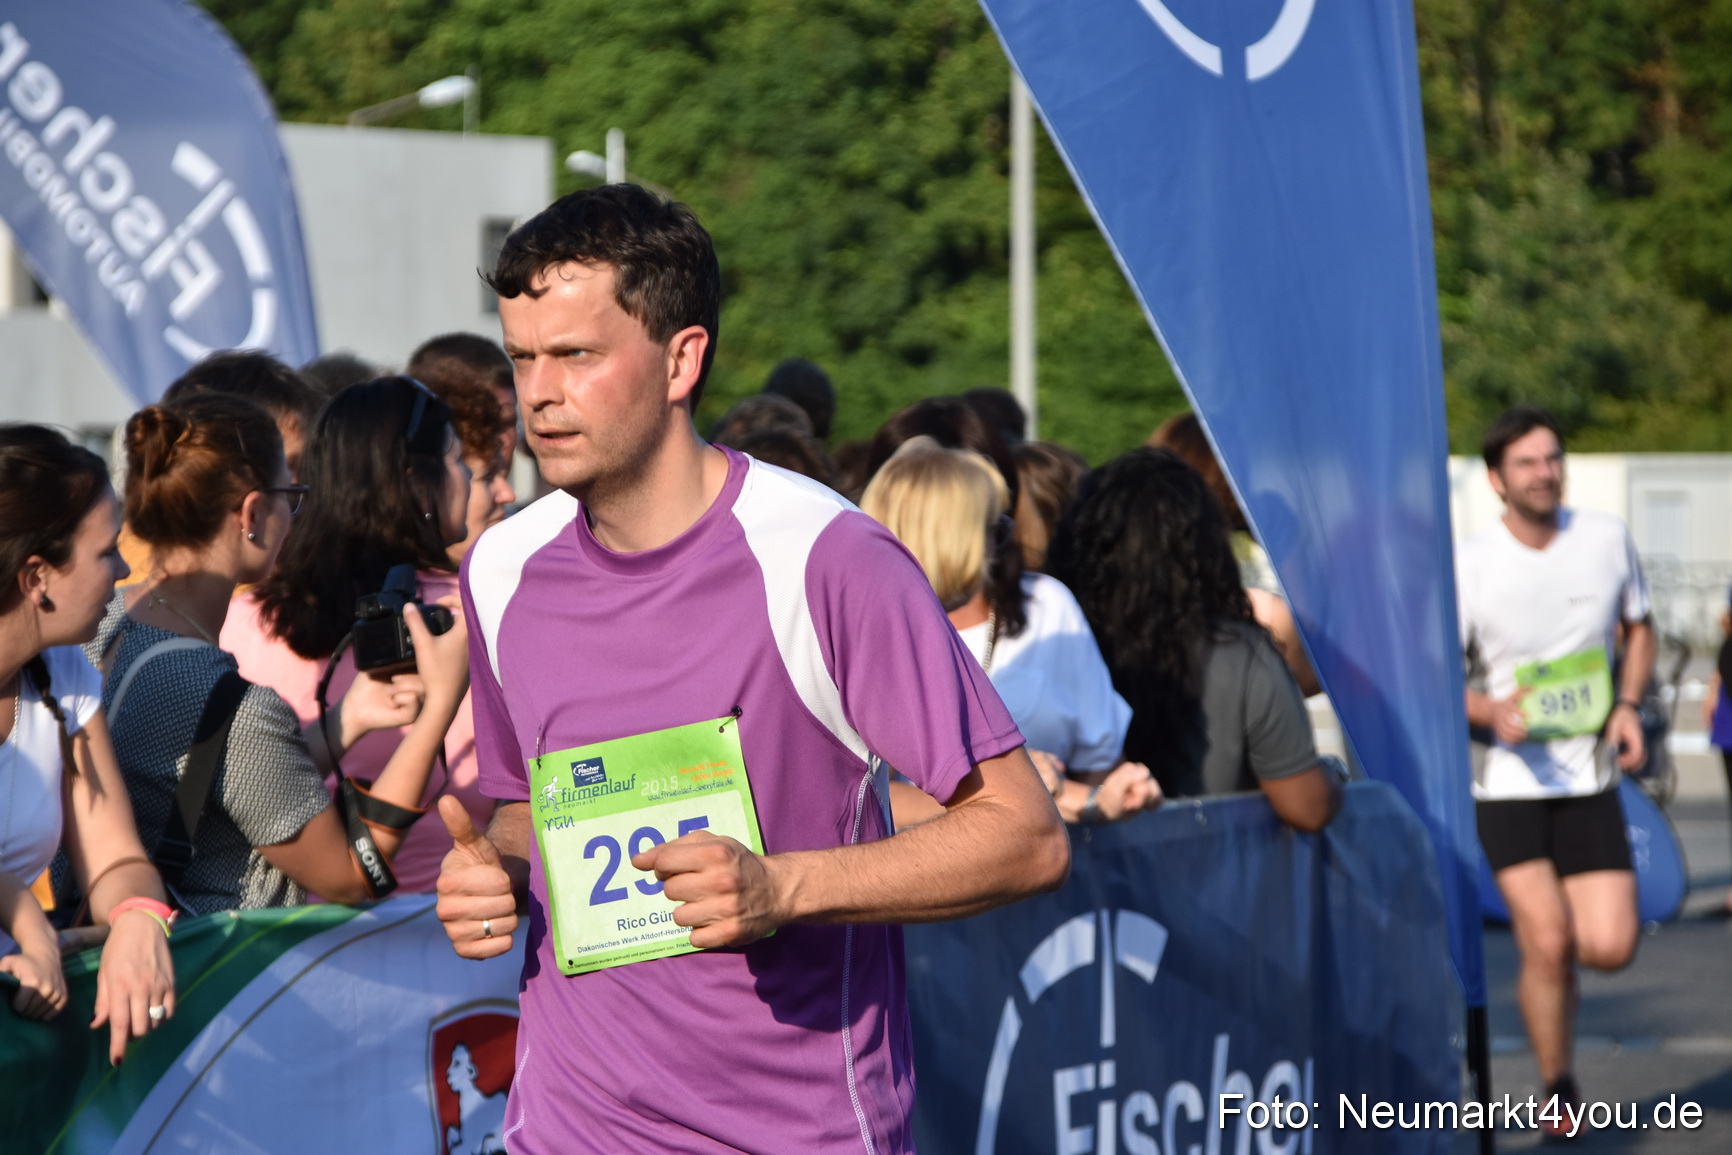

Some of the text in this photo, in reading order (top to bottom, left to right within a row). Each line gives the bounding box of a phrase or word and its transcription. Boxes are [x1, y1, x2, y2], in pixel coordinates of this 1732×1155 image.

[1540, 683, 1592, 716] 981
[561, 773, 678, 804] firmenlauf 2015
[563, 798, 596, 809] neumarkt
[355, 836, 388, 888] SONY
[617, 917, 647, 931] Rico
[577, 939, 621, 953] Diakonisches
[622, 935, 640, 945] Werk
